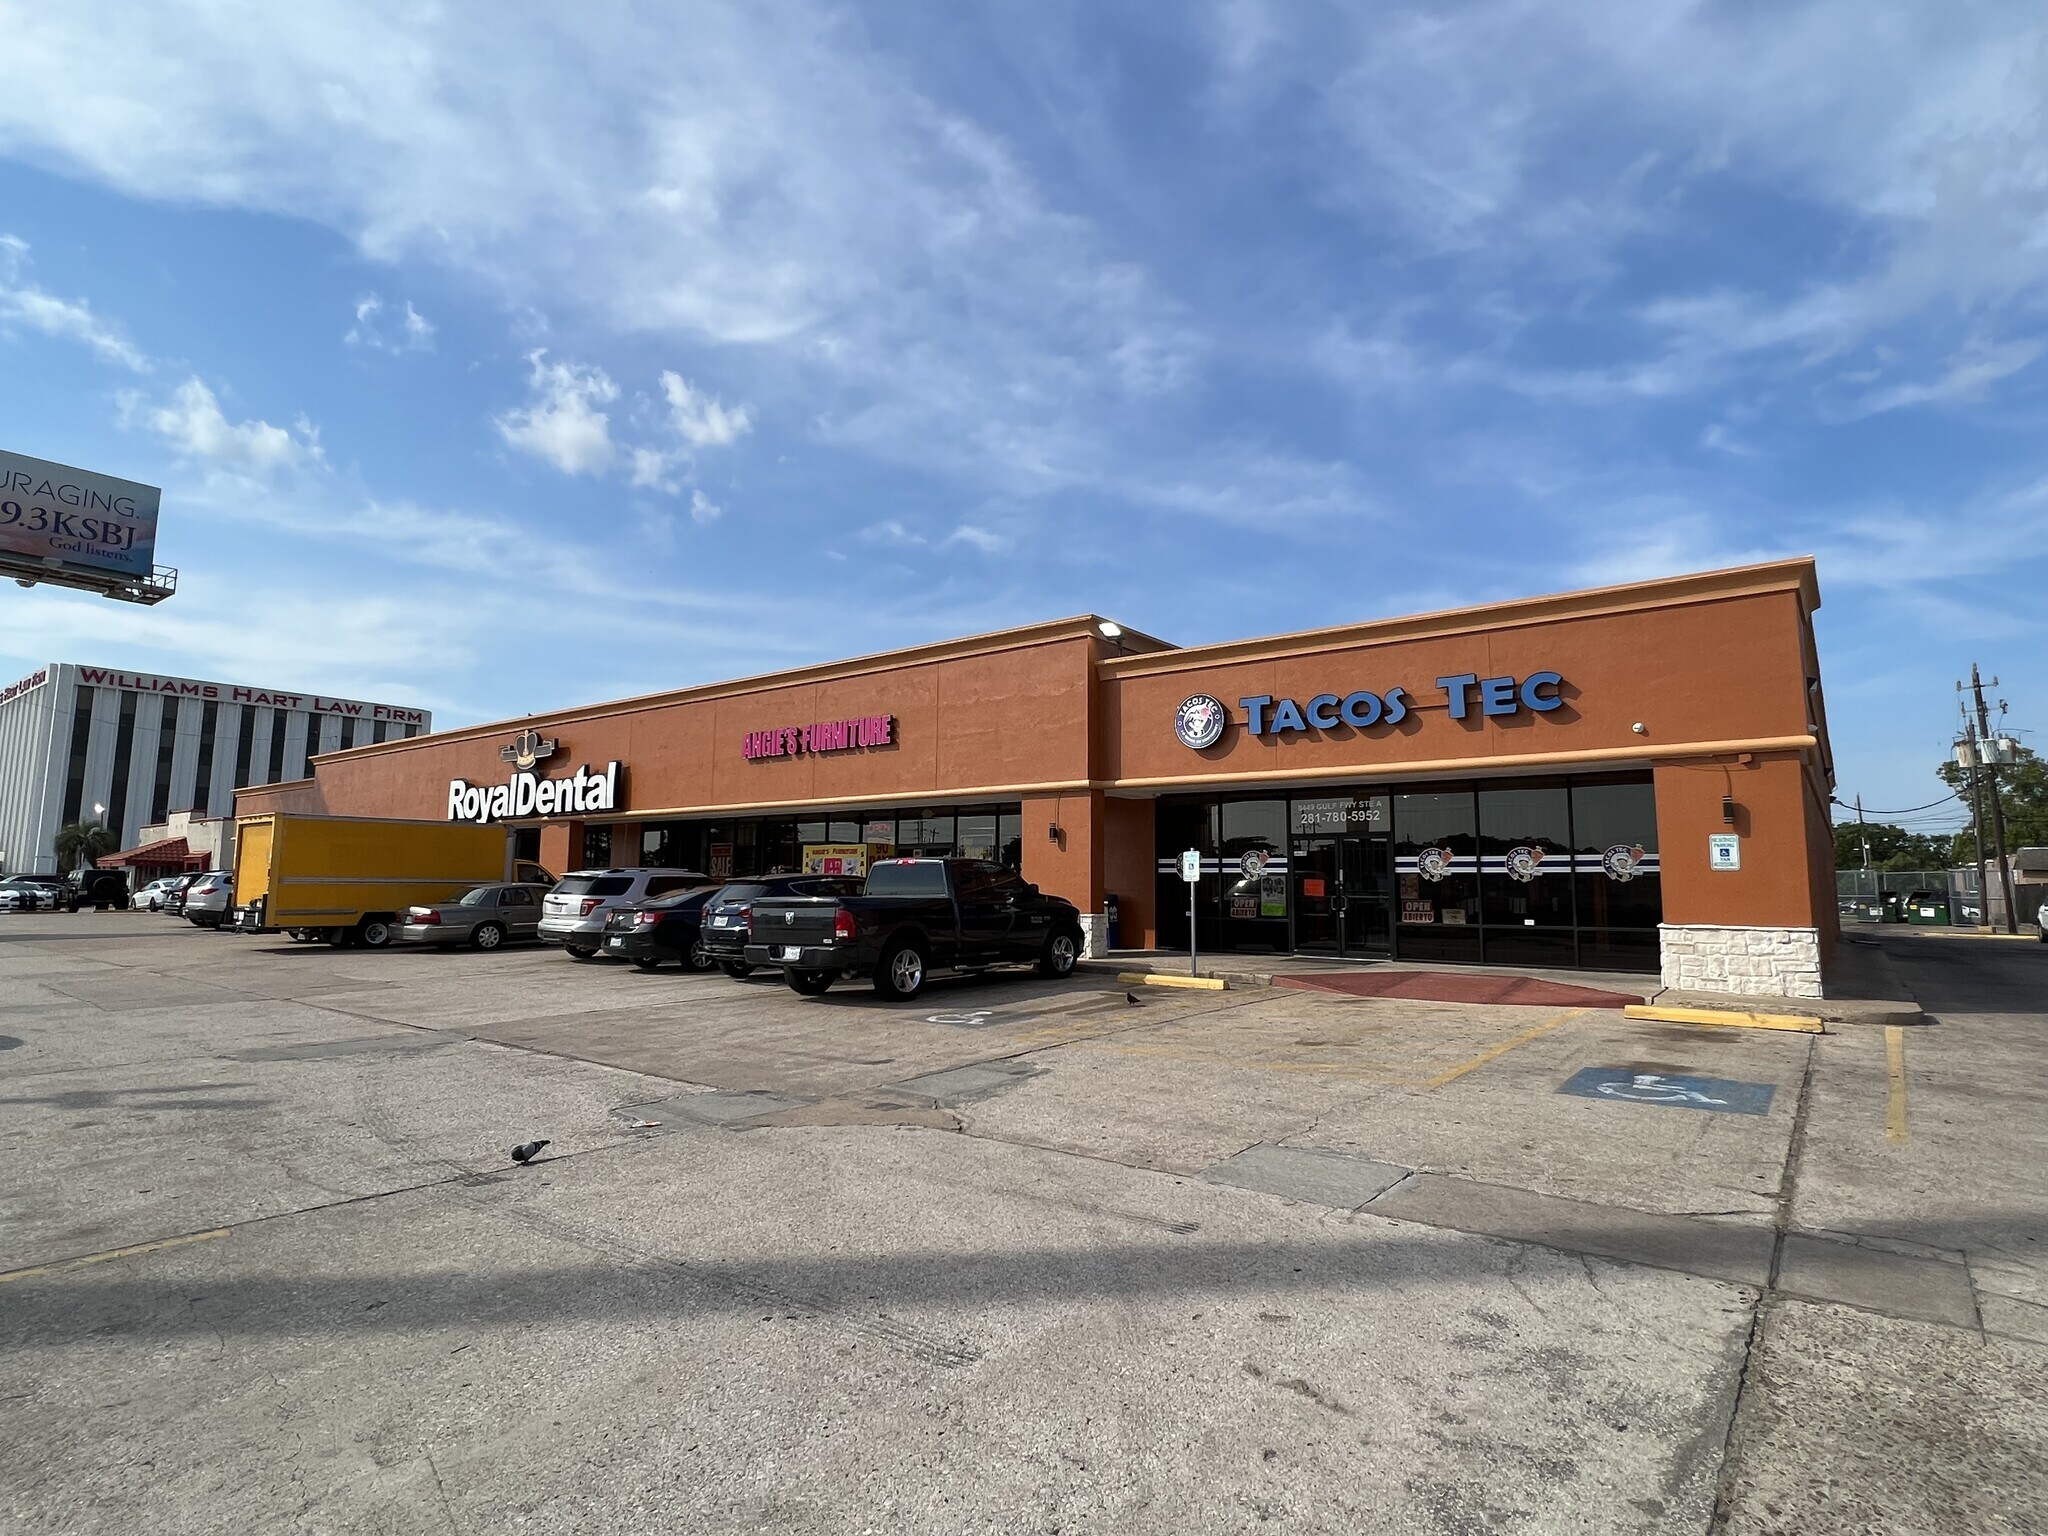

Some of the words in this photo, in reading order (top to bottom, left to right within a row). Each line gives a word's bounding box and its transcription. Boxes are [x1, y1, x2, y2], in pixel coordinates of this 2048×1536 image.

[49, 537, 82, 552] God
[86, 542, 133, 562] listens.
[80, 667, 219, 698] WILLIAMS
[232, 687, 302, 708] HART
[314, 698, 363, 715] LAW
[373, 705, 422, 723] FIRM
[1239, 687, 1407, 735] TACOS
[1435, 671, 1564, 719] TEC
[1178, 697, 1203, 716] TACOS
[1204, 698, 1218, 714] TEC
[741, 726, 798, 760] ANGIE'S
[801, 714, 891, 753] FURNITURE
[1316, 802, 1337, 810] GULF
[1339, 801, 1357, 809] FWY
[1358, 800, 1374, 808] STE
[1375, 800, 1382, 808] A
[1300, 810, 1381, 824] 281-780-5952
[1405, 901, 1431, 911] OPEN
[1403, 912, 1433, 921] ABIERTO
